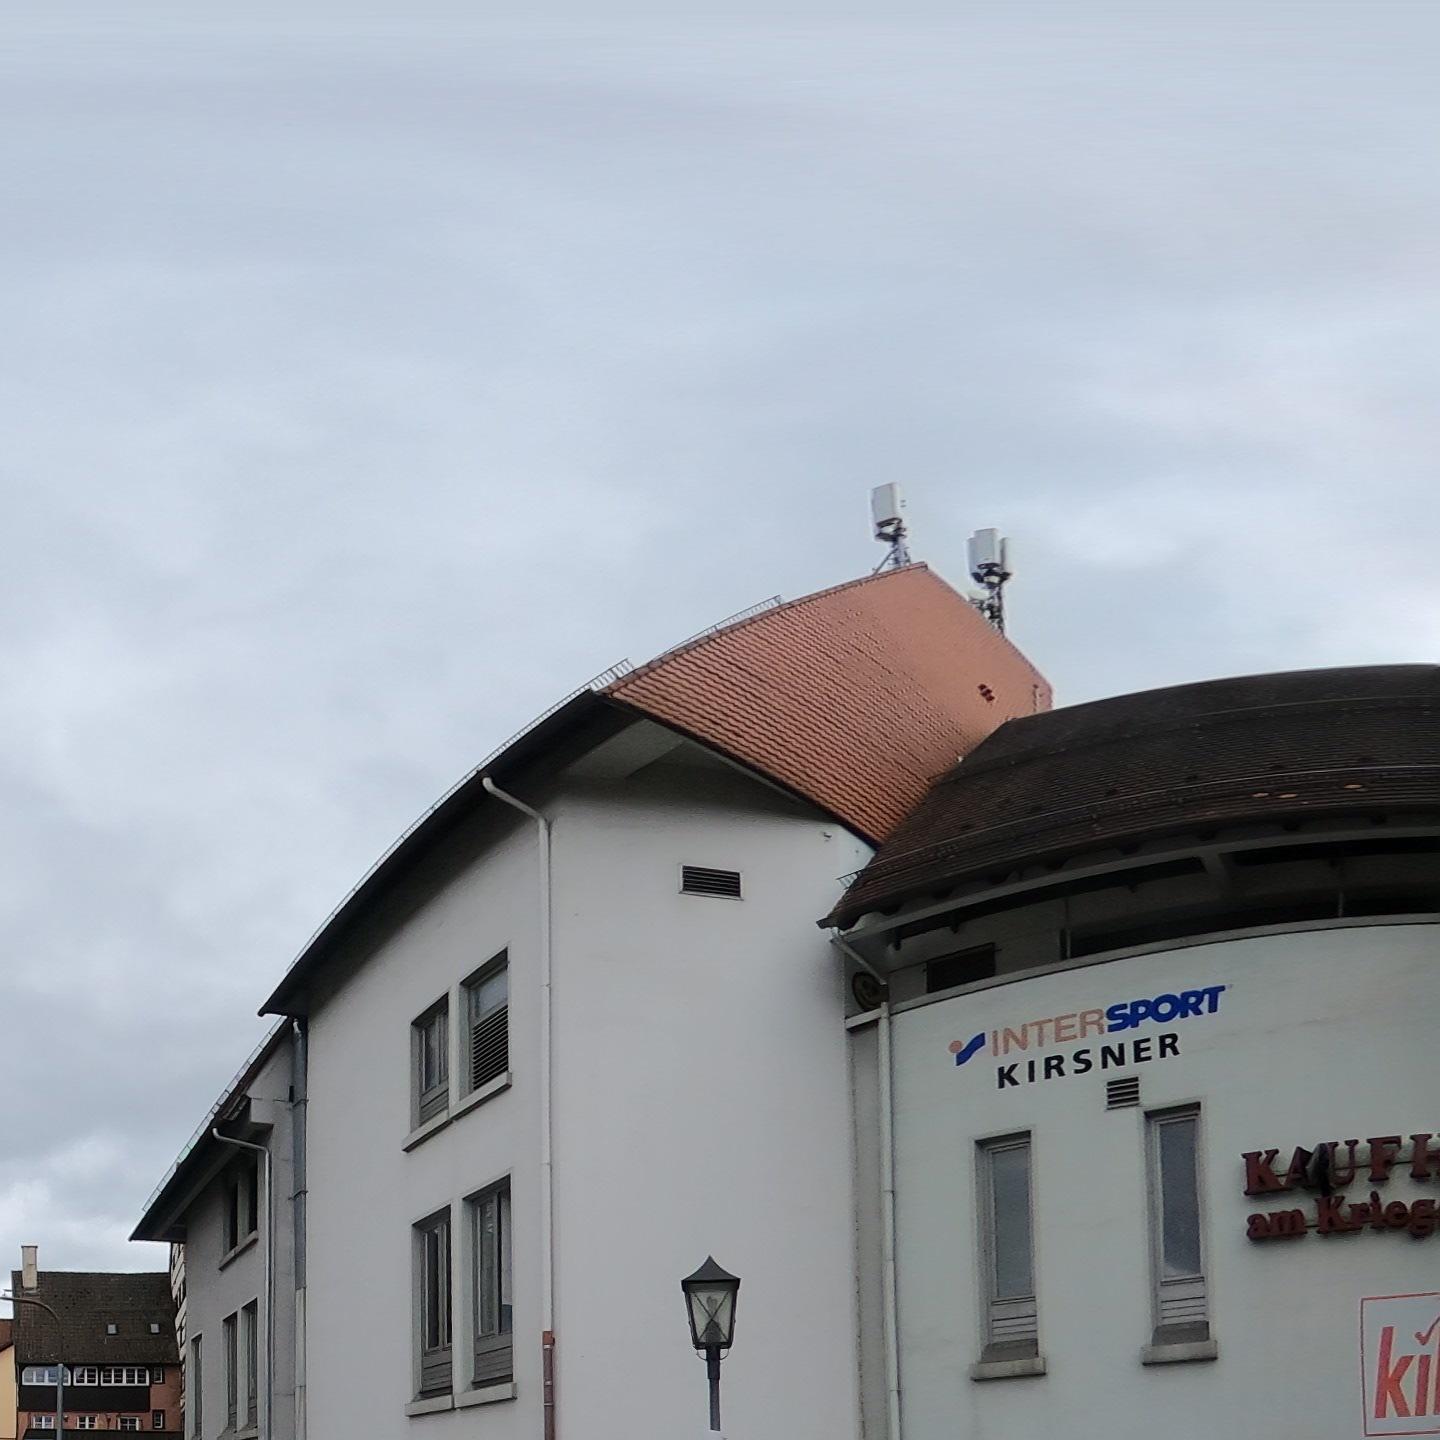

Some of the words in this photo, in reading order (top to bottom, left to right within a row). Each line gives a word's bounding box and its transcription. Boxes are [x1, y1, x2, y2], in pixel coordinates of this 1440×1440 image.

[992, 985, 1226, 1056] INTERSPORT
[998, 1032, 1181, 1090] KIRSNER
[1246, 1207, 1307, 1240] am
